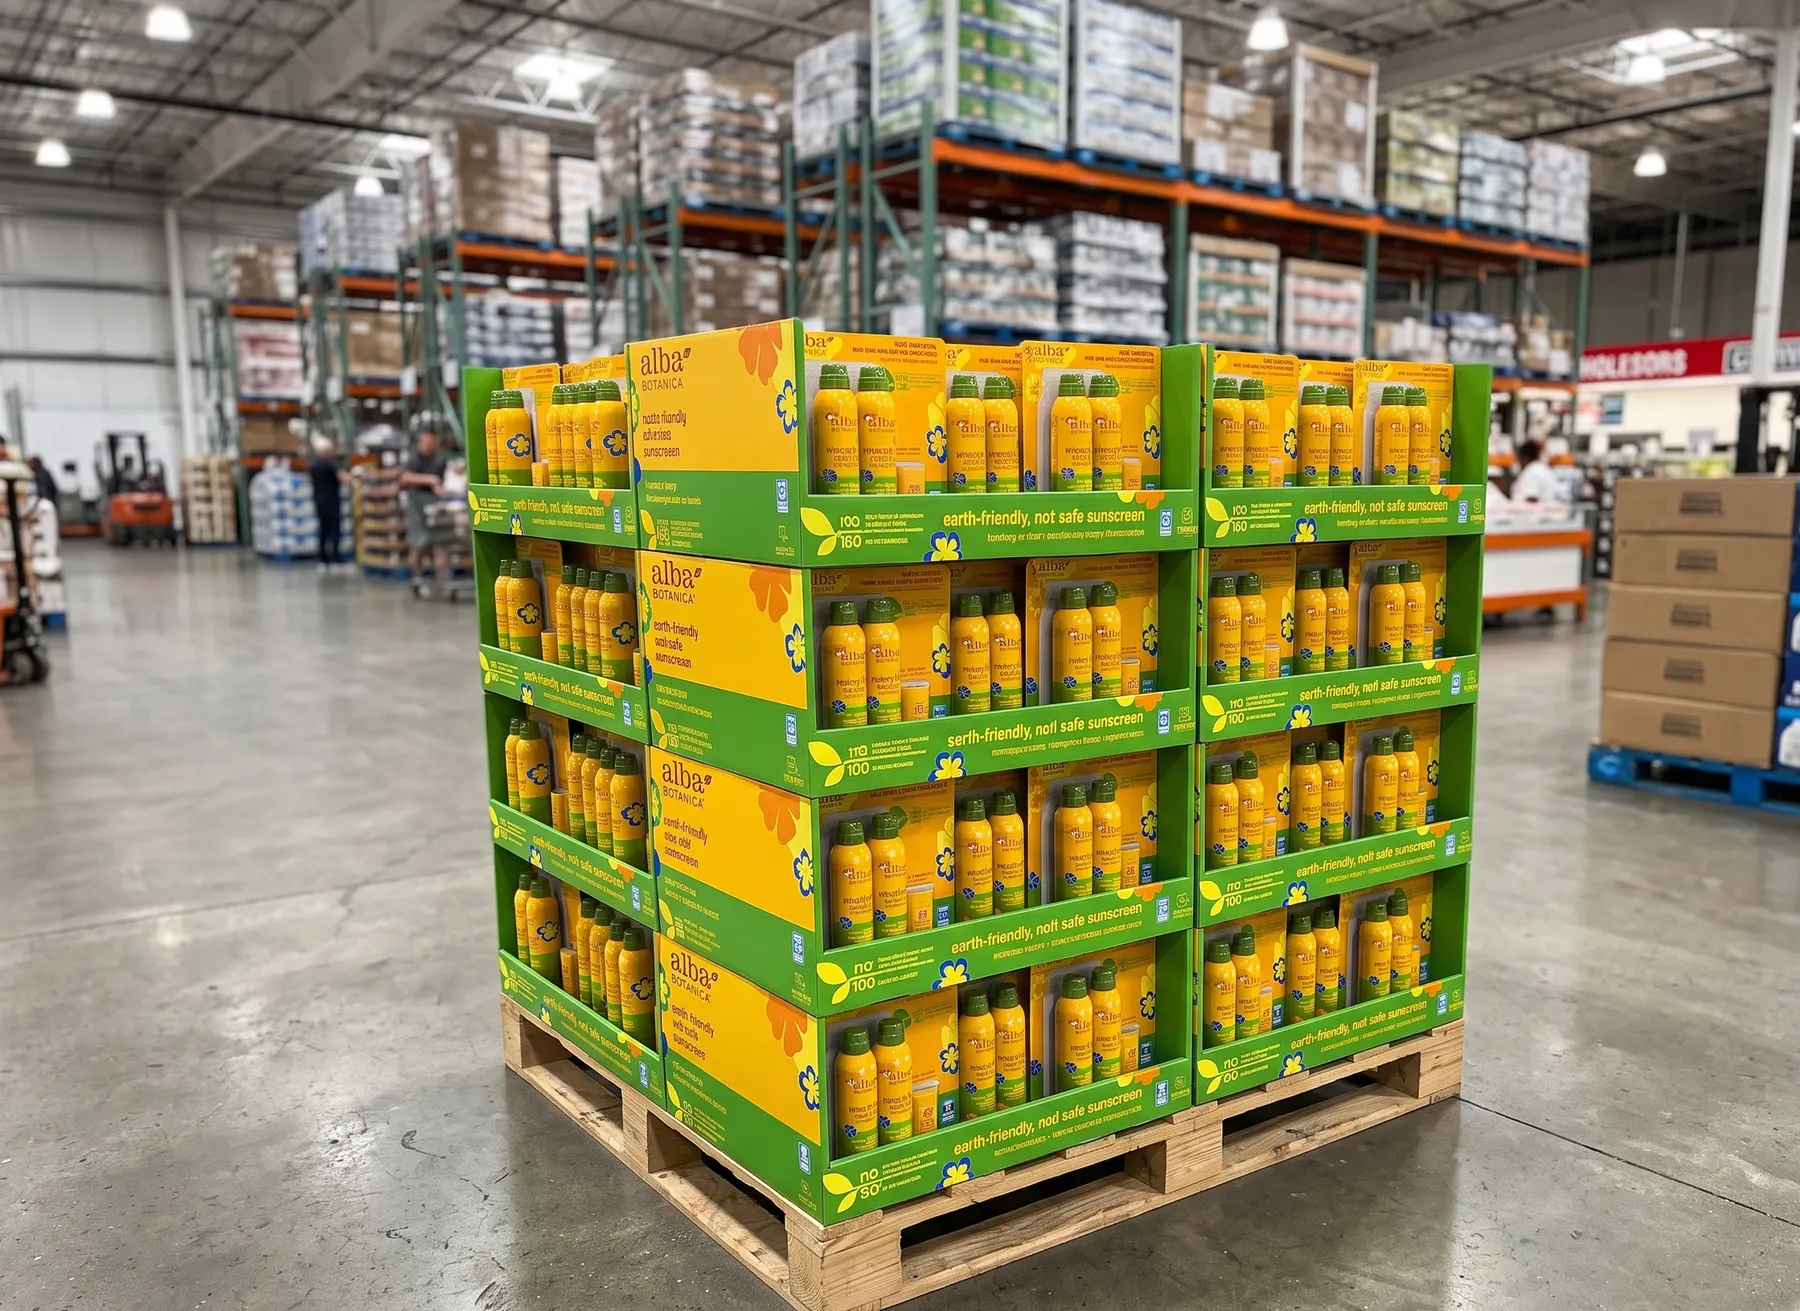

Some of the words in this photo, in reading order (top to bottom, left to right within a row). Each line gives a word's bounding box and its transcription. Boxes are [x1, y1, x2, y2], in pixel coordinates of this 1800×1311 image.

[641, 347, 685, 376] alba
[642, 378, 684, 391] BOTANICA
[1304, 501, 1367, 516] earth-friendly,
[1369, 501, 1385, 512] not
[1387, 500, 1405, 512] safe
[1407, 500, 1448, 512] sunscreen
[840, 515, 860, 528] 100
[943, 508, 1031, 528] earth-friendly,
[1034, 511, 1056, 525] not
[1058, 509, 1084, 524] safe
[1087, 509, 1145, 524] sunscreen
[841, 535, 862, 549] 160
[652, 560, 695, 589] alba
[652, 588, 694, 604] BOTANICA
[1380, 677, 1399, 692] safe
[1400, 674, 1442, 689] sunscreen
[1060, 716, 1085, 733] safe
[1088, 712, 1144, 731] sunscreen
[1228, 712, 1245, 725] 100
[662, 760, 705, 794] alba
[847, 762, 870, 777] 100
[662, 785, 704, 809] BOTANICA
[1296, 854, 1356, 878] earth-friendly,
[1376, 845, 1393, 859] safe
[1394, 839, 1436, 856] sunscreen
[1225, 895, 1242, 908] 100
[951, 926, 1033, 954] earth-friendly,
[1061, 914, 1085, 931] safe
[1087, 904, 1143, 924] sunscreen
[670, 952, 712, 990] alba
[671, 973, 711, 1004] BOTANICA
[851, 977, 875, 993] 100
[1369, 1012, 1387, 1026] safe
[1223, 1057, 1239, 1069] no
[1061, 1104, 1085, 1123] safe
[1087, 1088, 1143, 1112] sunscreen
[860, 1168, 879, 1184] no
